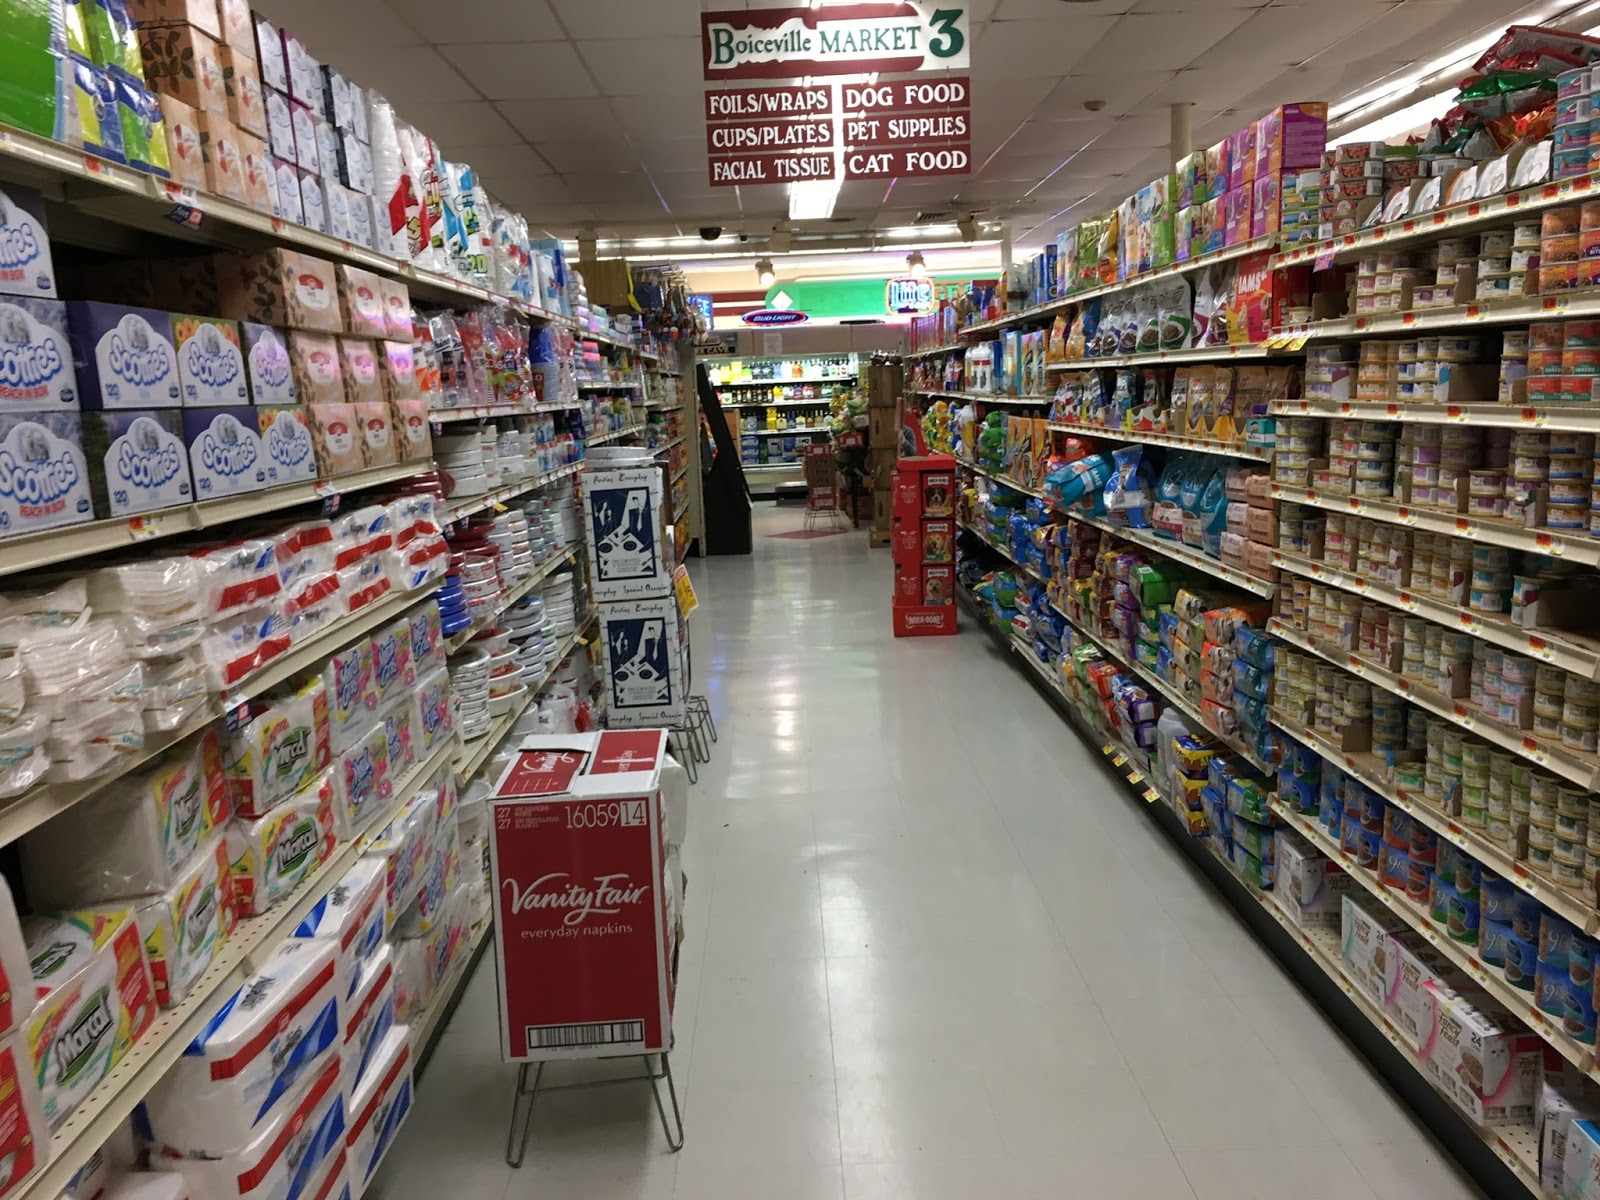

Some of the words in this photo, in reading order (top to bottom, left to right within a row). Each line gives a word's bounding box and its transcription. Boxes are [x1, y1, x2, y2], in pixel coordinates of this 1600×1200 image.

[713, 28, 811, 65] Boiceville
[819, 25, 921, 55] MARKET
[928, 8, 965, 58] 3
[709, 89, 829, 115] FOILS/WRAPS
[846, 86, 894, 109] DOG
[904, 83, 965, 105] FOOD
[712, 123, 831, 148] CUPS/PLATES
[847, 120, 880, 141] PET
[888, 116, 967, 139] SUPPLIES
[713, 160, 766, 181] FACIAL
[774, 157, 831, 178] TISSUE
[849, 153, 894, 174] CAT
[905, 150, 967, 172] FOOD
[1238, 271, 1261, 294] IAMS
[118, 440, 181, 488] Scotties
[202, 434, 257, 477] Scotties
[497, 807, 511, 818] 27
[497, 818, 512, 830] 27
[520, 925, 579, 940] everyday
[583, 922, 633, 938] napkins
[55, 990, 114, 1082] Marcal
[1438, 1012, 1462, 1039] Fancy
[1440, 1026, 1460, 1048] Feast
[1470, 1032, 1482, 1048] 24
